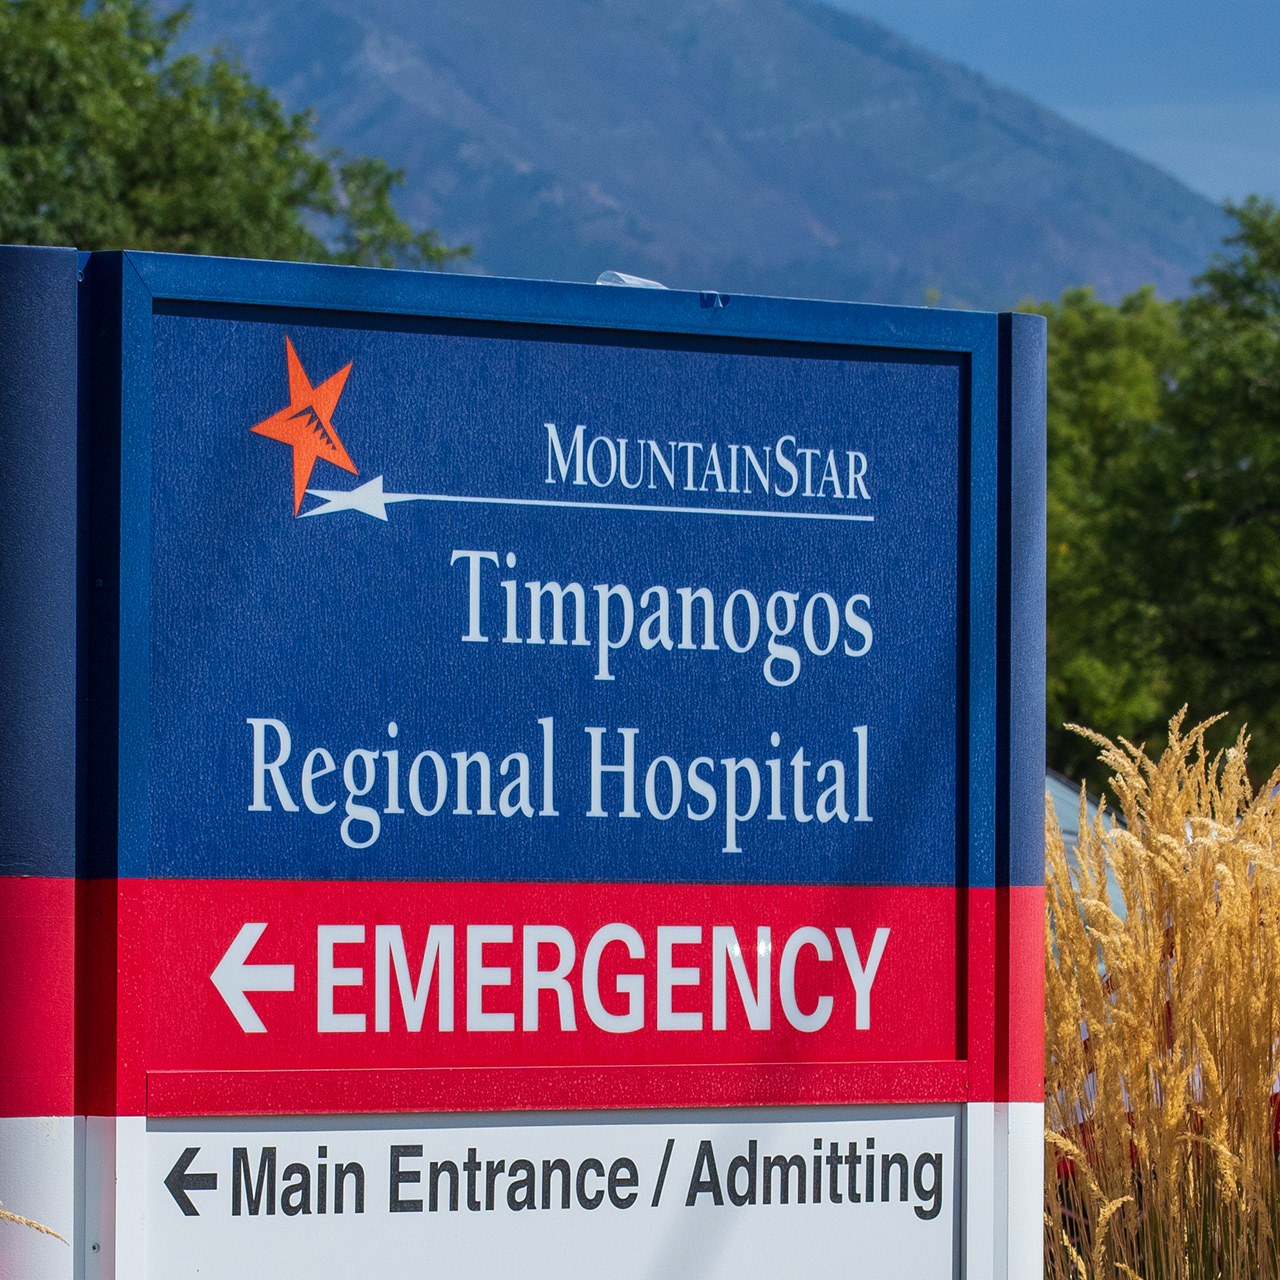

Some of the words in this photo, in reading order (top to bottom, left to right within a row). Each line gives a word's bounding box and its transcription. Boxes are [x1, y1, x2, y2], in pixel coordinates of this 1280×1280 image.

[449, 548, 874, 687] Timpanogos
[245, 716, 561, 850] Regional
[583, 723, 874, 854] Hospital
[316, 922, 891, 1034] EMERGENCY
[230, 1144, 366, 1218] Main
[388, 1143, 640, 1213] Entrance
[684, 1136, 944, 1222] Admitting
